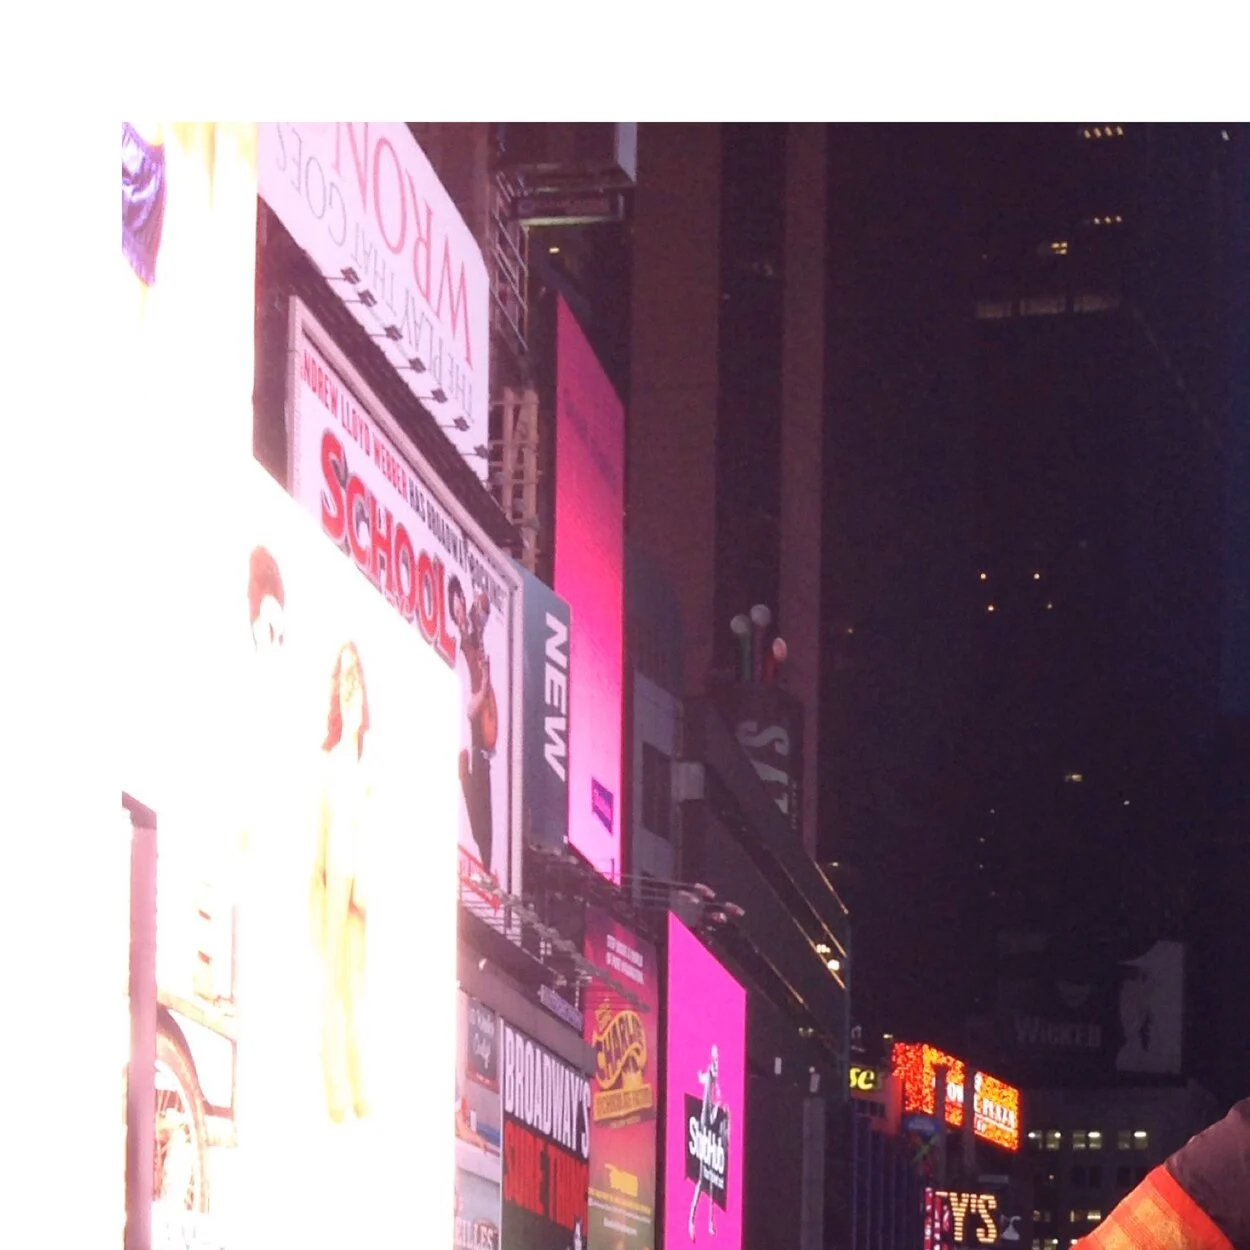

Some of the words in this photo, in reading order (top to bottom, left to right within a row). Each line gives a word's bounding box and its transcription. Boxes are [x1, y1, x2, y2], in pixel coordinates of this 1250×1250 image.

[340, 393, 370, 457] LLOYD
[372, 431, 409, 503] WEBBER
[319, 427, 455, 668] SCHOOL
[544, 611, 568, 783] NEW
[503, 1025, 591, 1159] BROADWAY'S
